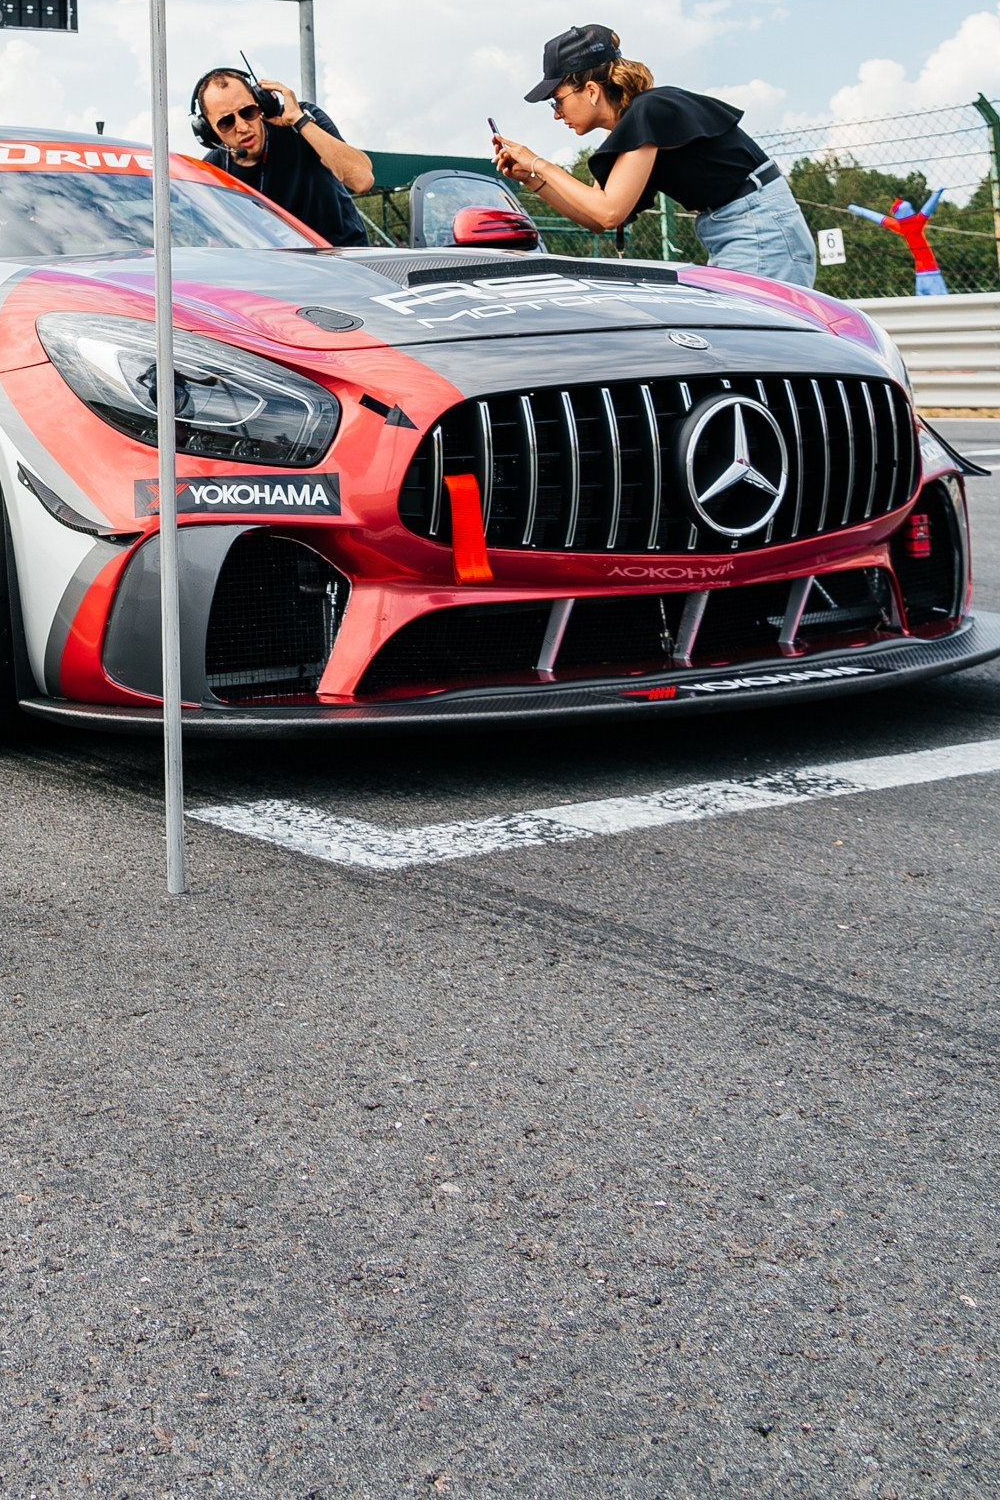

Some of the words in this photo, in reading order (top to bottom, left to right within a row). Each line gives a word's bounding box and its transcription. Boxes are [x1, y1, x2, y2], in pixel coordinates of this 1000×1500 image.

[826, 232, 836, 249] 6
[188, 484, 330, 506] YOKOHAMA
[680, 666, 876, 692] YOKOHAMA
